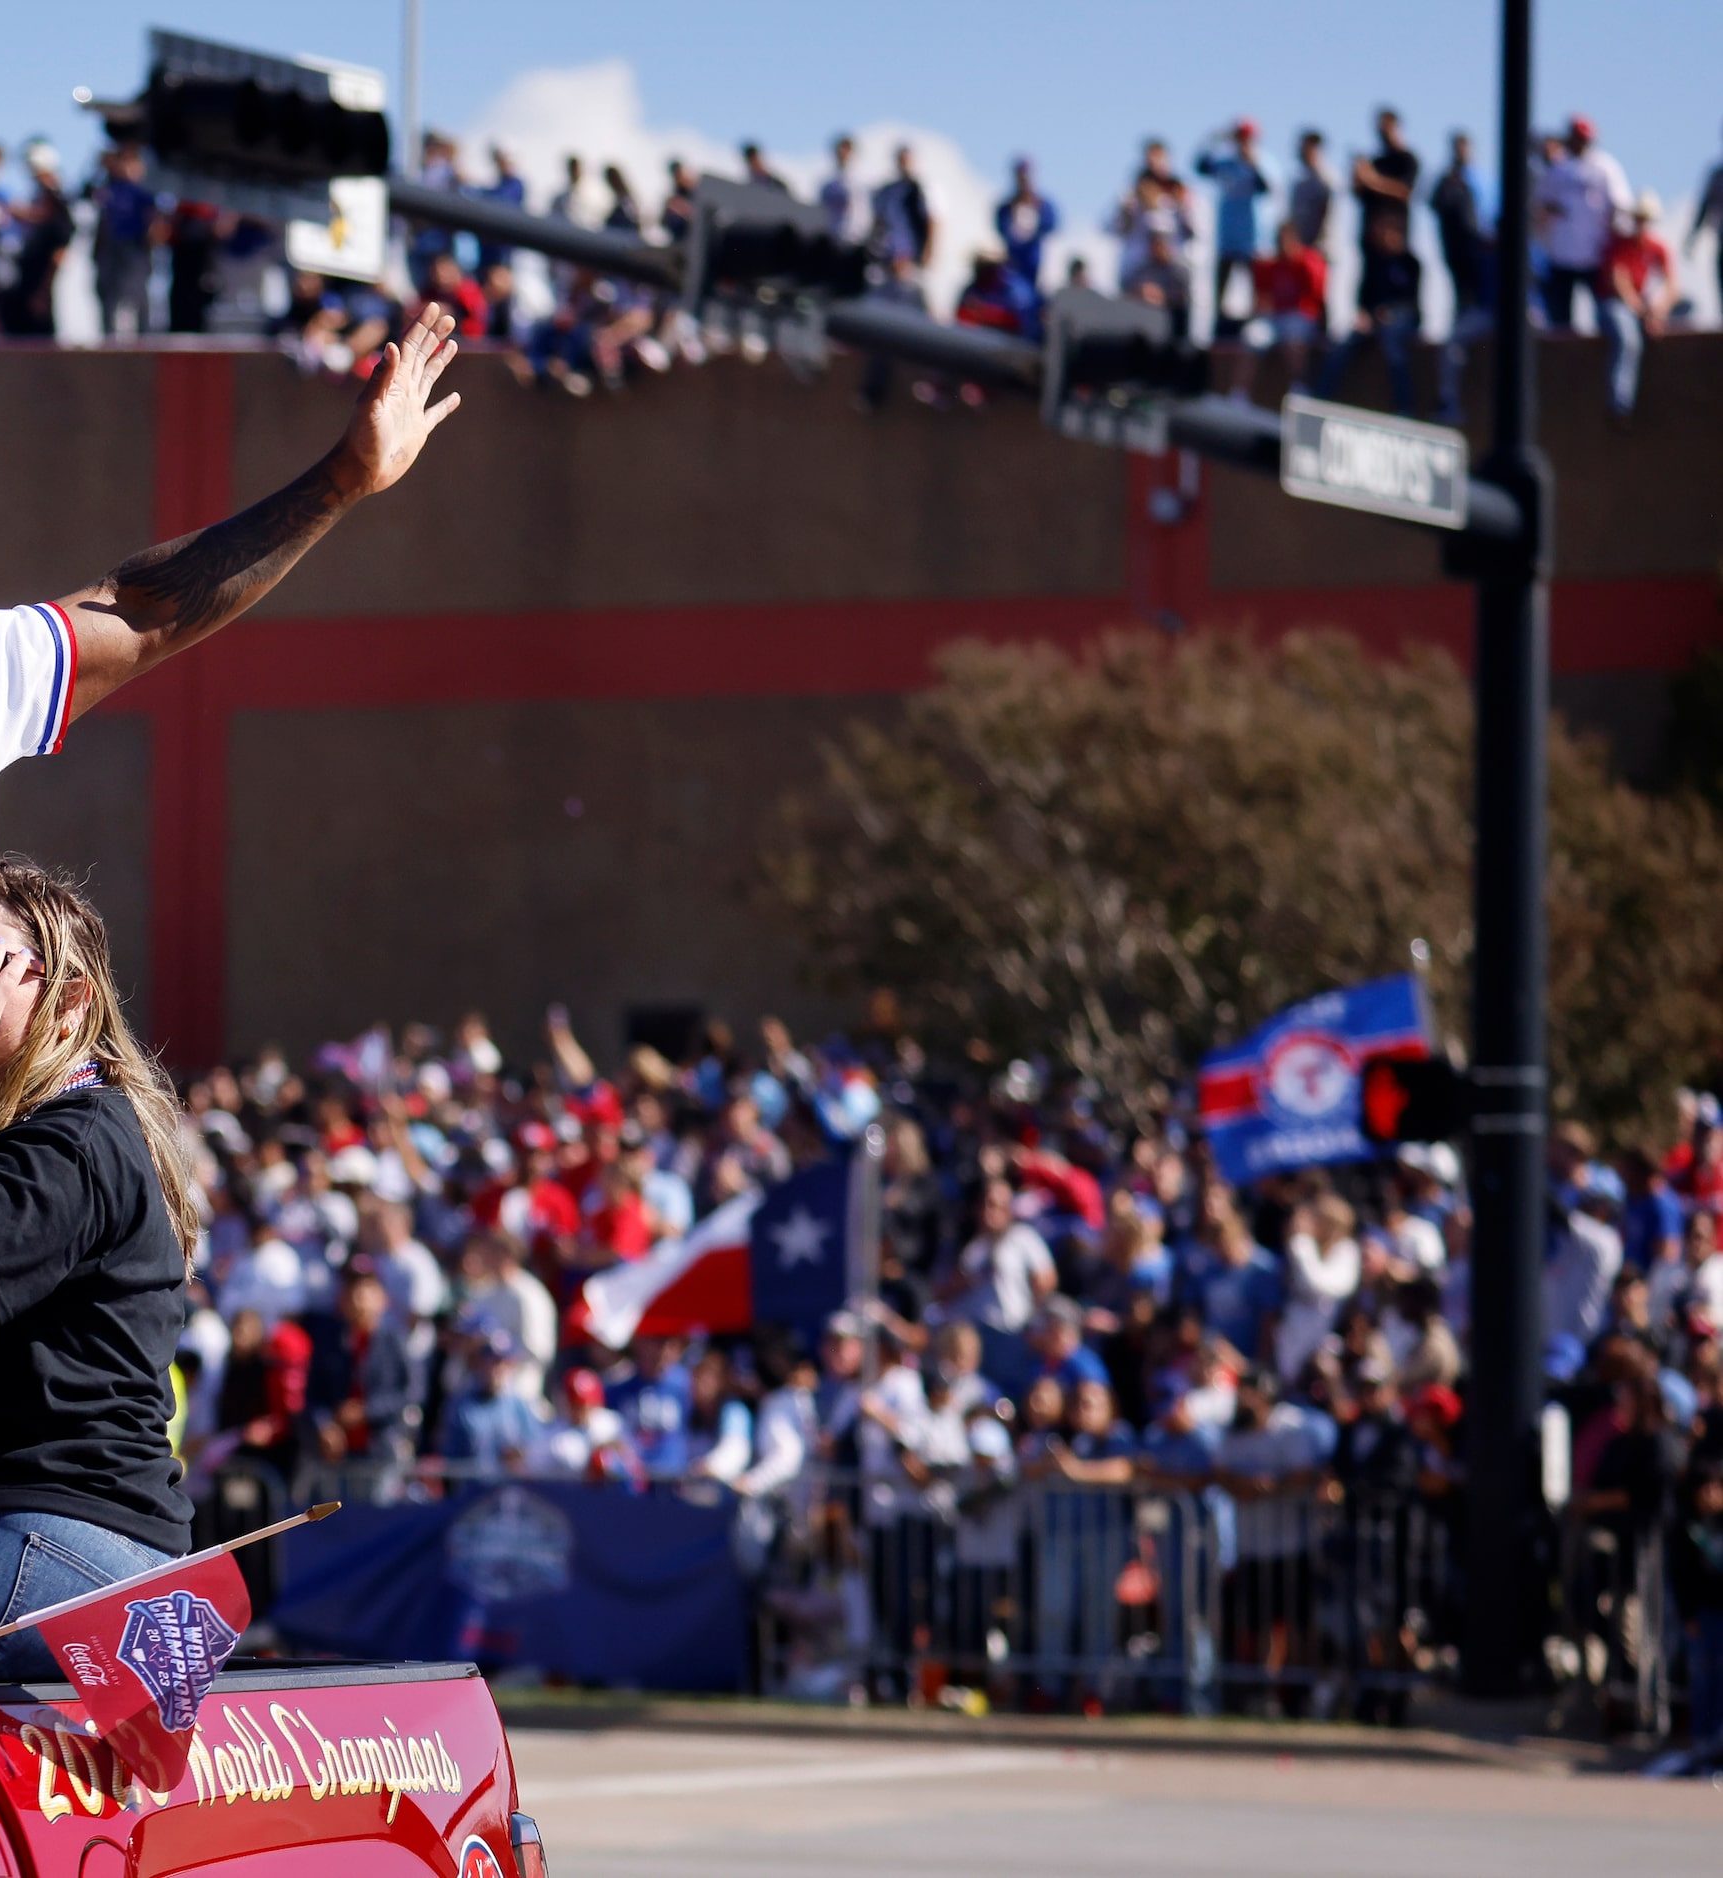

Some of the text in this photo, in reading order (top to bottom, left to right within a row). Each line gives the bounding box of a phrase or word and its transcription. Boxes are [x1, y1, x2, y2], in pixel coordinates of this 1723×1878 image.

[62, 1643, 109, 1686] Coca-Cola
[145, 1628, 170, 1687] 20 23
[148, 1601, 195, 1725] CHAMPIONS
[182, 1626, 214, 1698] WORLD
[187, 1703, 294, 1807] World
[268, 1701, 463, 1824] Champions
